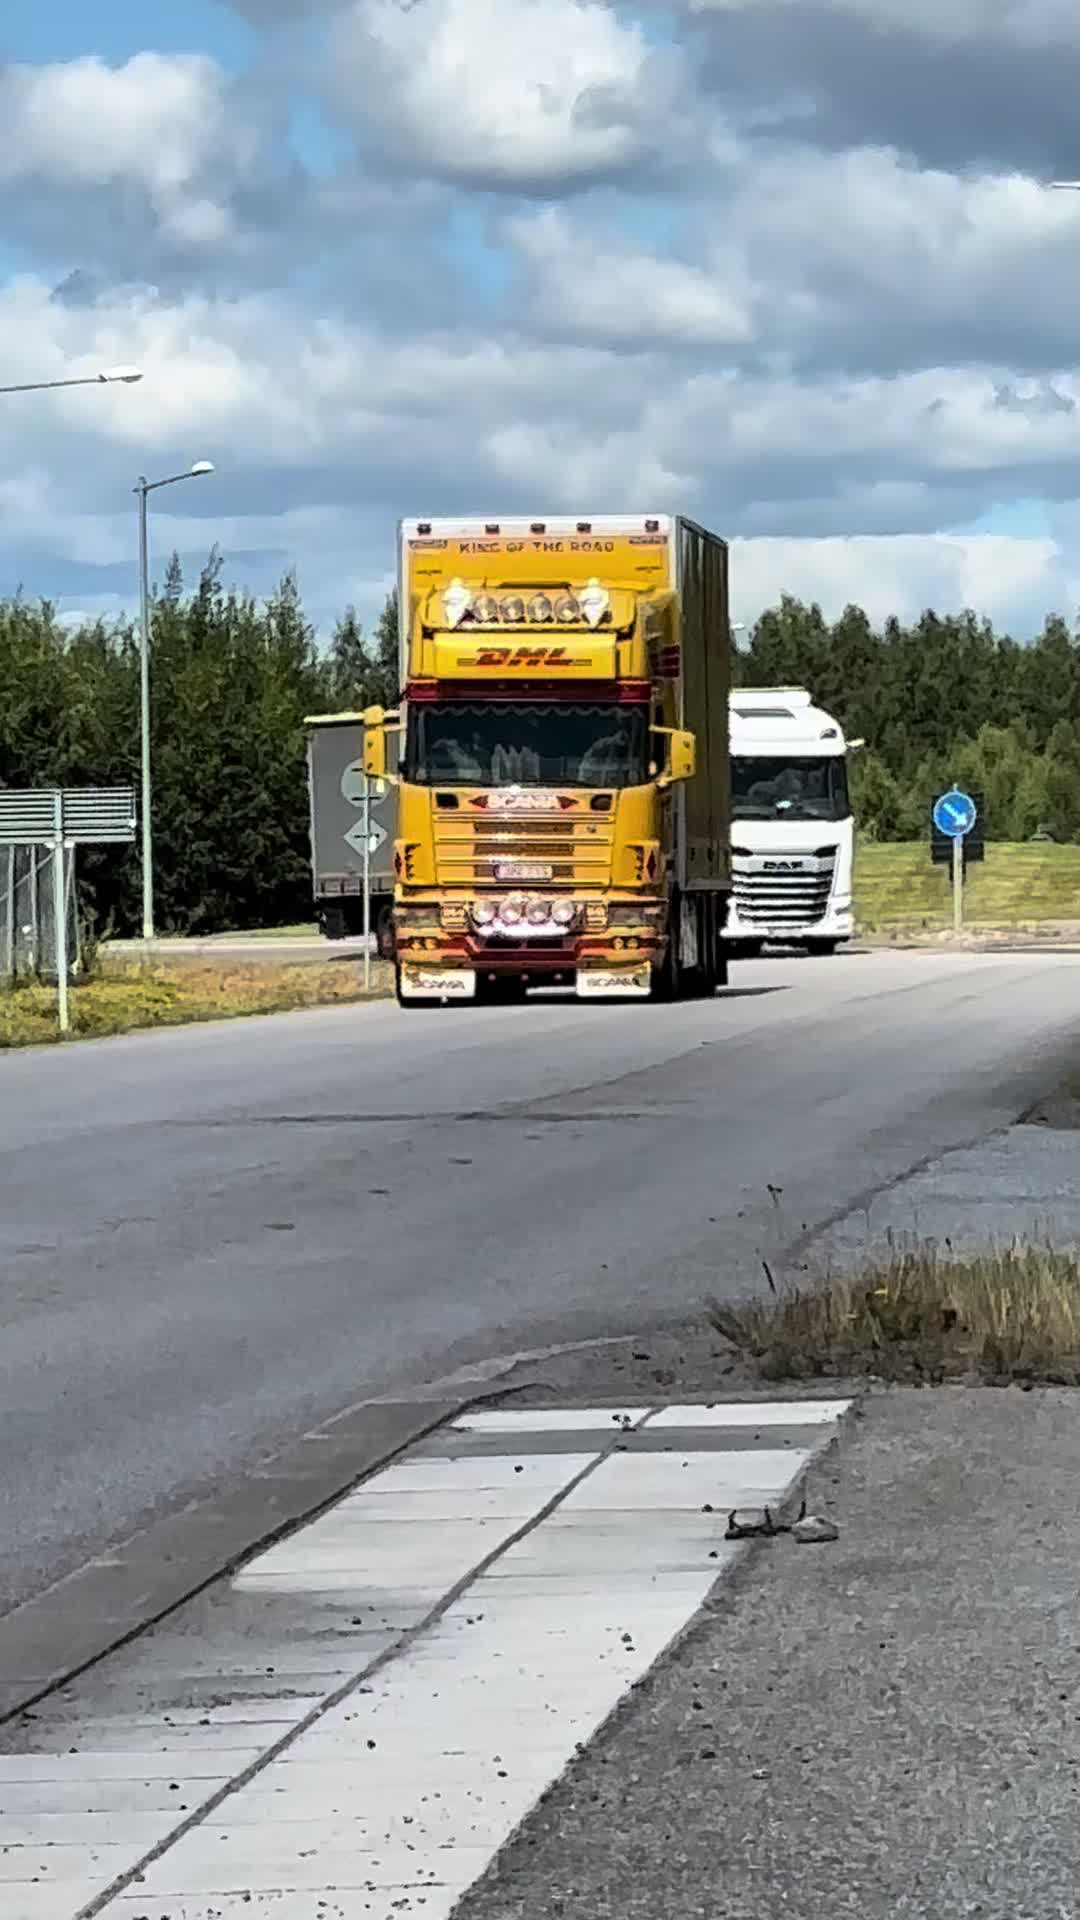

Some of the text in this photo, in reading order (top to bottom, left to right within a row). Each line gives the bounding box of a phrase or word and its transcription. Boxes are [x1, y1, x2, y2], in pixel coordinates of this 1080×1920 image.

[570, 541, 615, 552] ROAD
[475, 647, 574, 666] DHL
[763, 861, 803, 869] DAF
